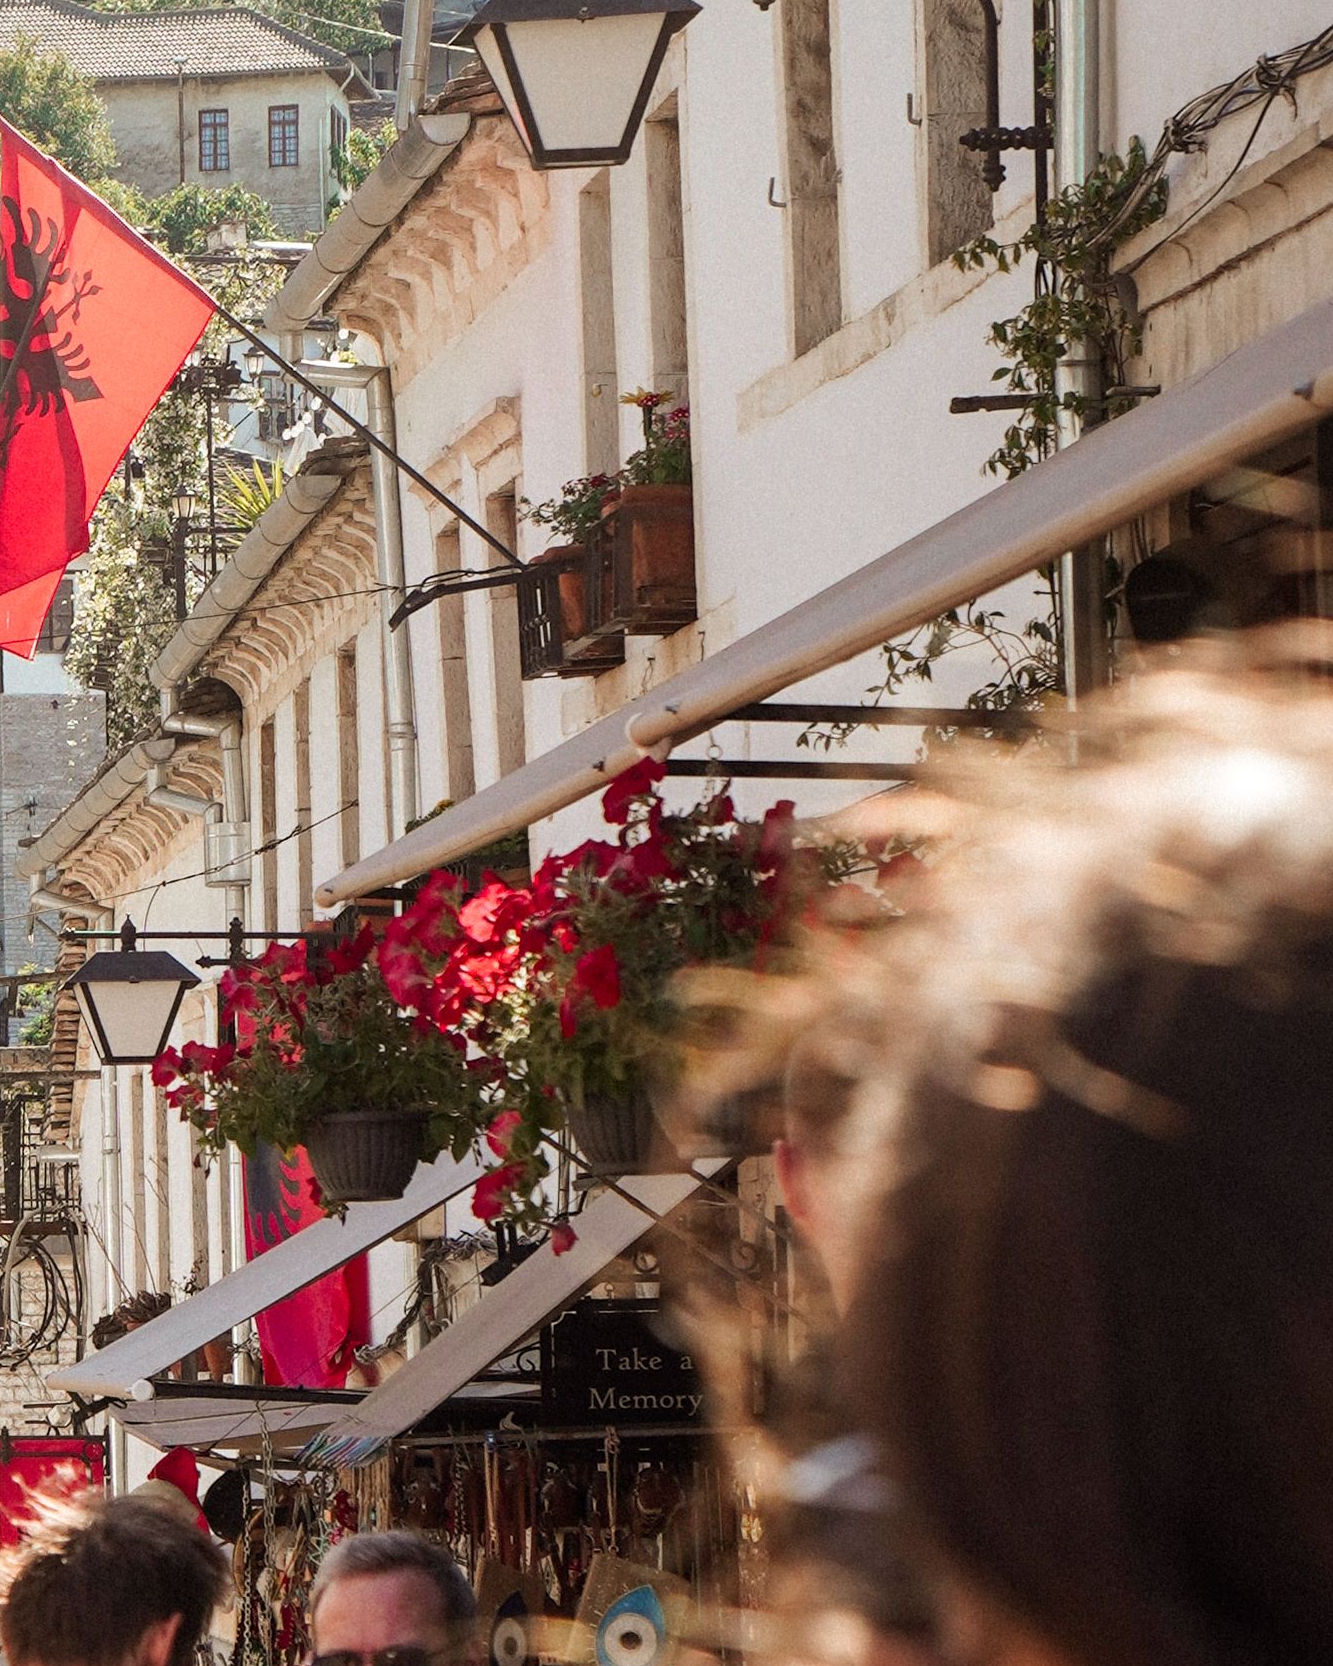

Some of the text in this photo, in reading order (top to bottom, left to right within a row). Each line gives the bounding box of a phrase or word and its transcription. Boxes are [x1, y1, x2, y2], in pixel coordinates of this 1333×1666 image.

[595, 1347, 693, 1371] Take a
[589, 1386, 704, 1416] Memory
